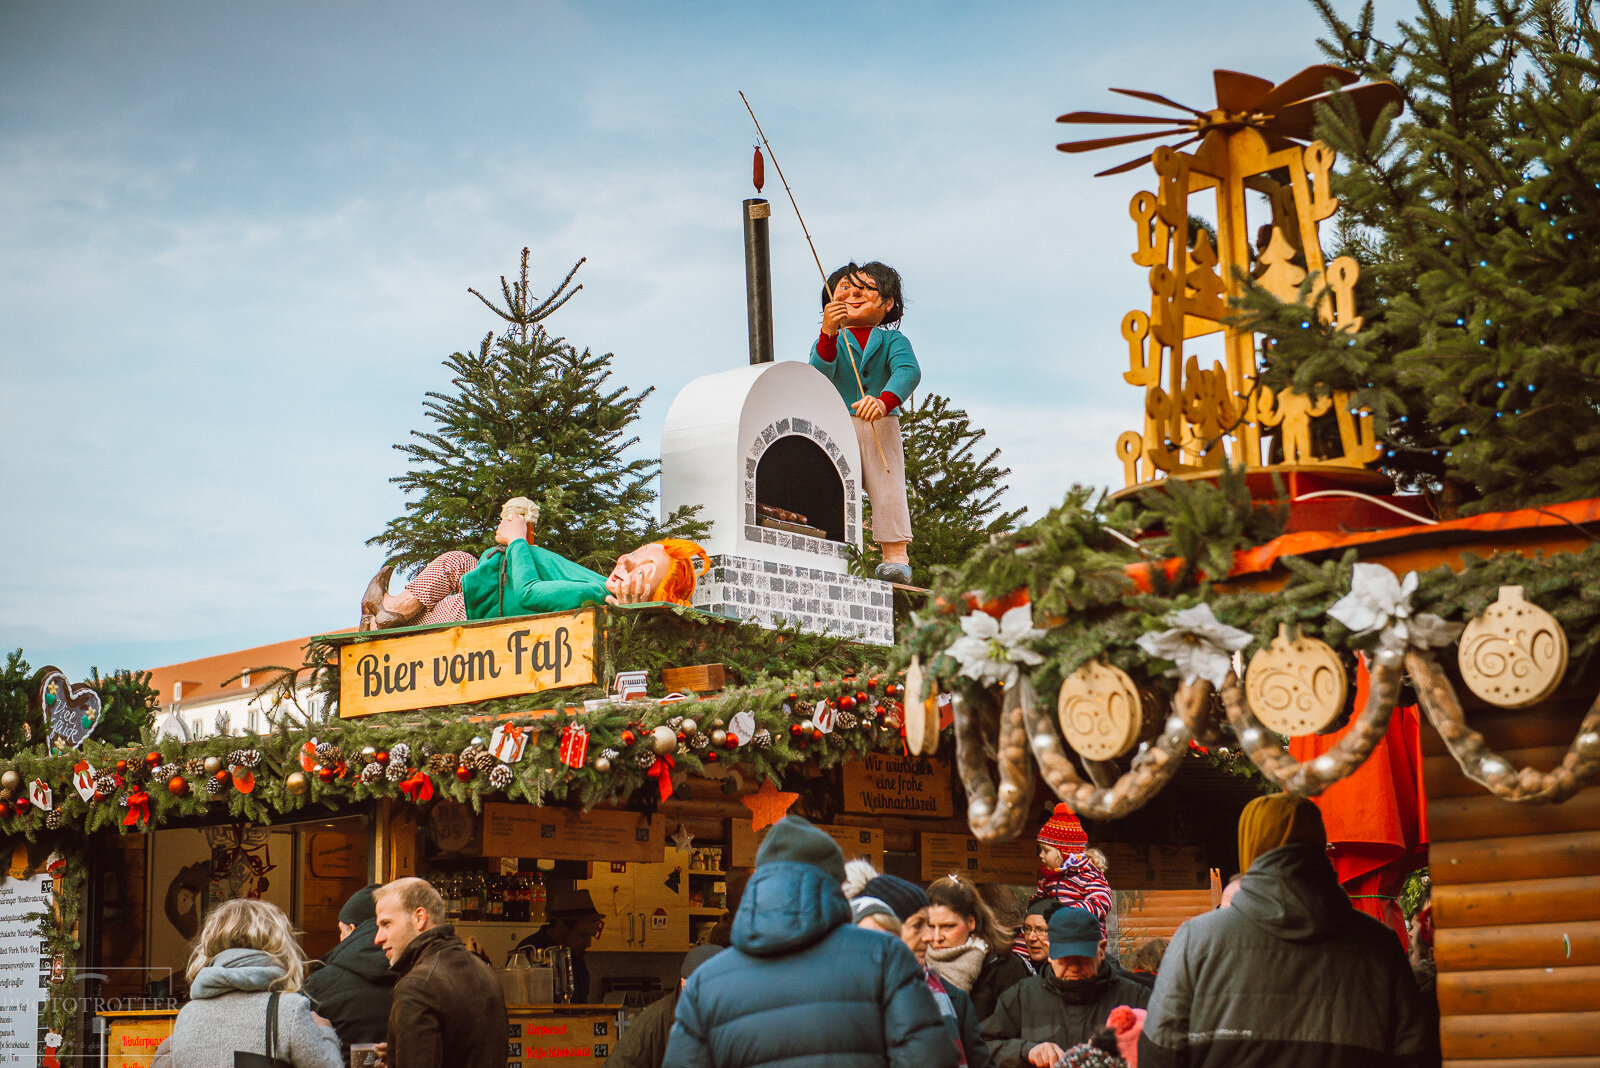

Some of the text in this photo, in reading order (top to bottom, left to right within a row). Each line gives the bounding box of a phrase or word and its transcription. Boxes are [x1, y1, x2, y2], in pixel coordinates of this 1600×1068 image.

[356, 626, 573, 698] Bier vom Faß
[54, 699, 76, 725] Viel
[864, 756, 882, 771] Wir
[876, 775, 924, 796] eine frohe
[860, 791, 937, 812] Weihnachtszeit
